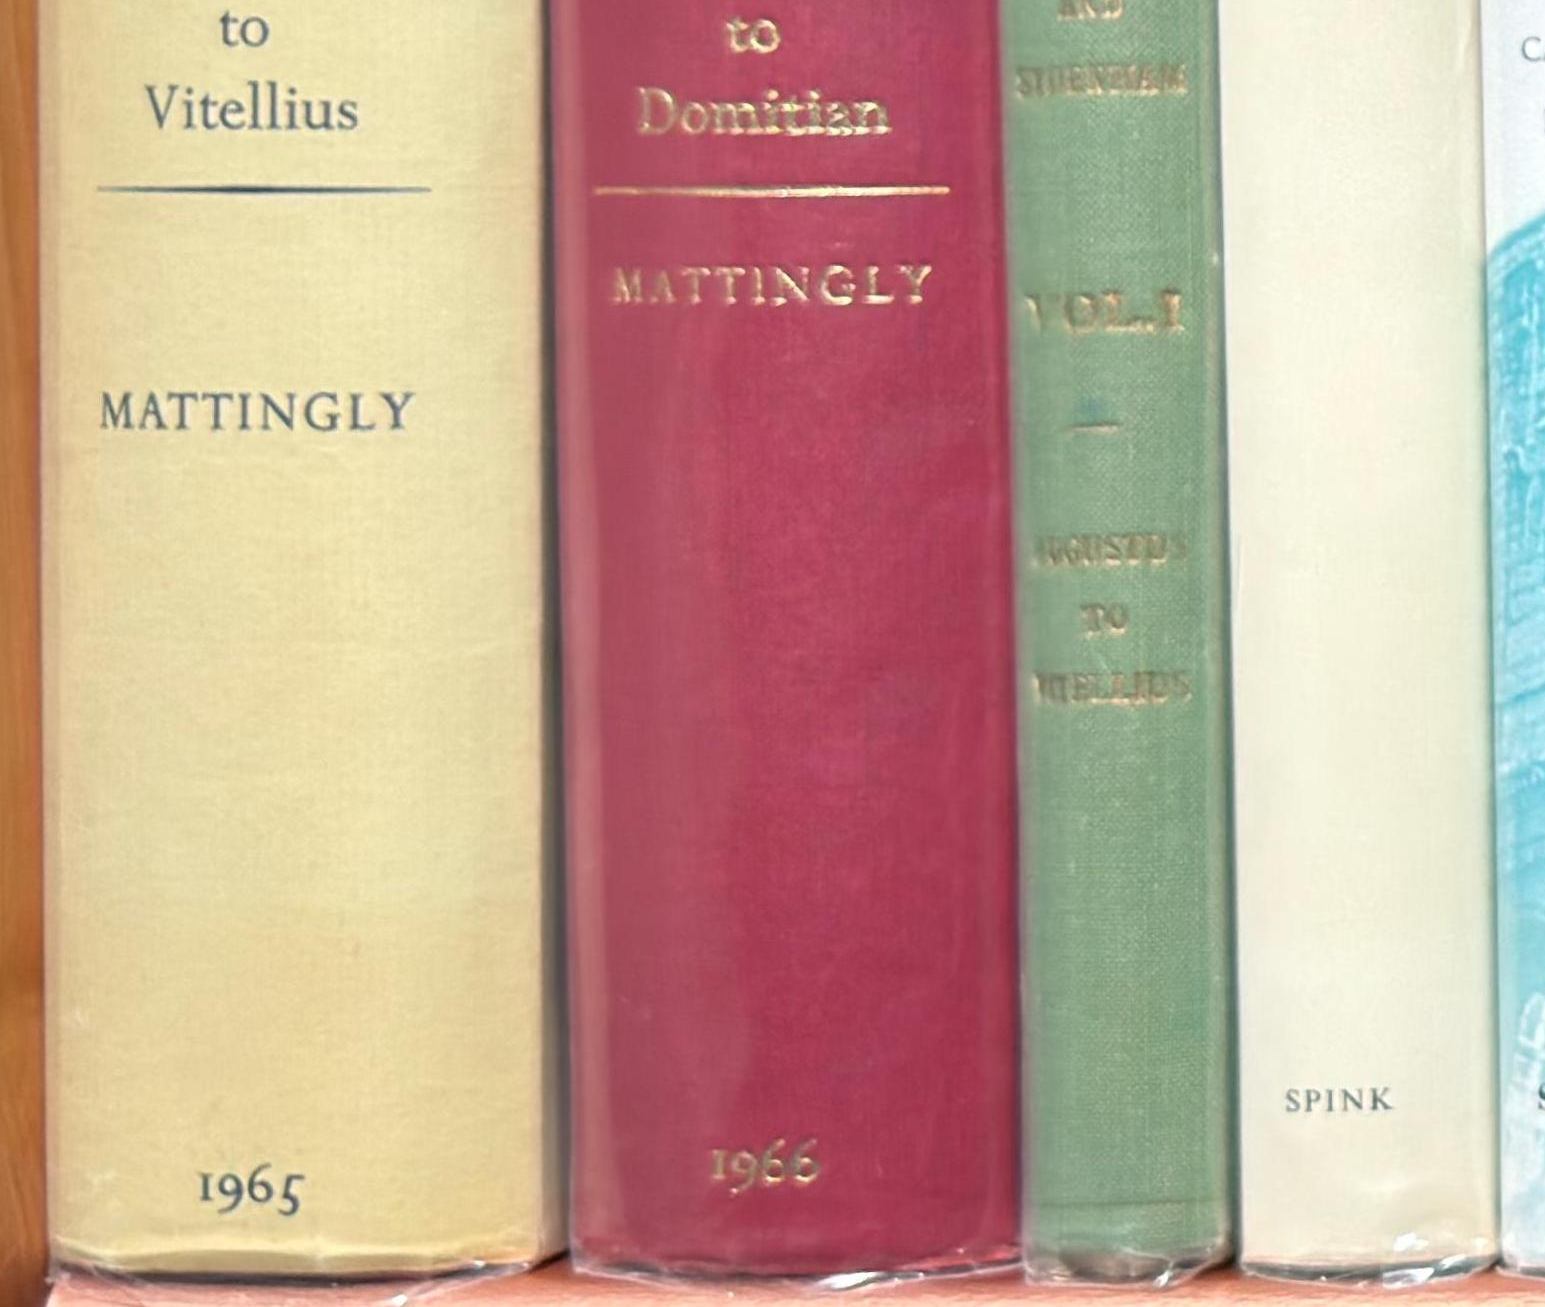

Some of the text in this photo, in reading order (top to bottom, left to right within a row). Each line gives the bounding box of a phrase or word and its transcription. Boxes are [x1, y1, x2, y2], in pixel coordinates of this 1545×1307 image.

[219, 10, 270, 48] to
[725, 16, 782, 54] to
[144, 80, 360, 132] Vitellius
[635, 87, 893, 136] Domitian
[611, 264, 934, 307] MATTINGLY
[99, 390, 417, 433] MATTINGLY
[1078, 603, 1130, 640] TO
[1285, 1086, 1395, 1115] SPINK
[200, 1162, 305, 1217] 1965
[709, 1136, 821, 1200] 1966
